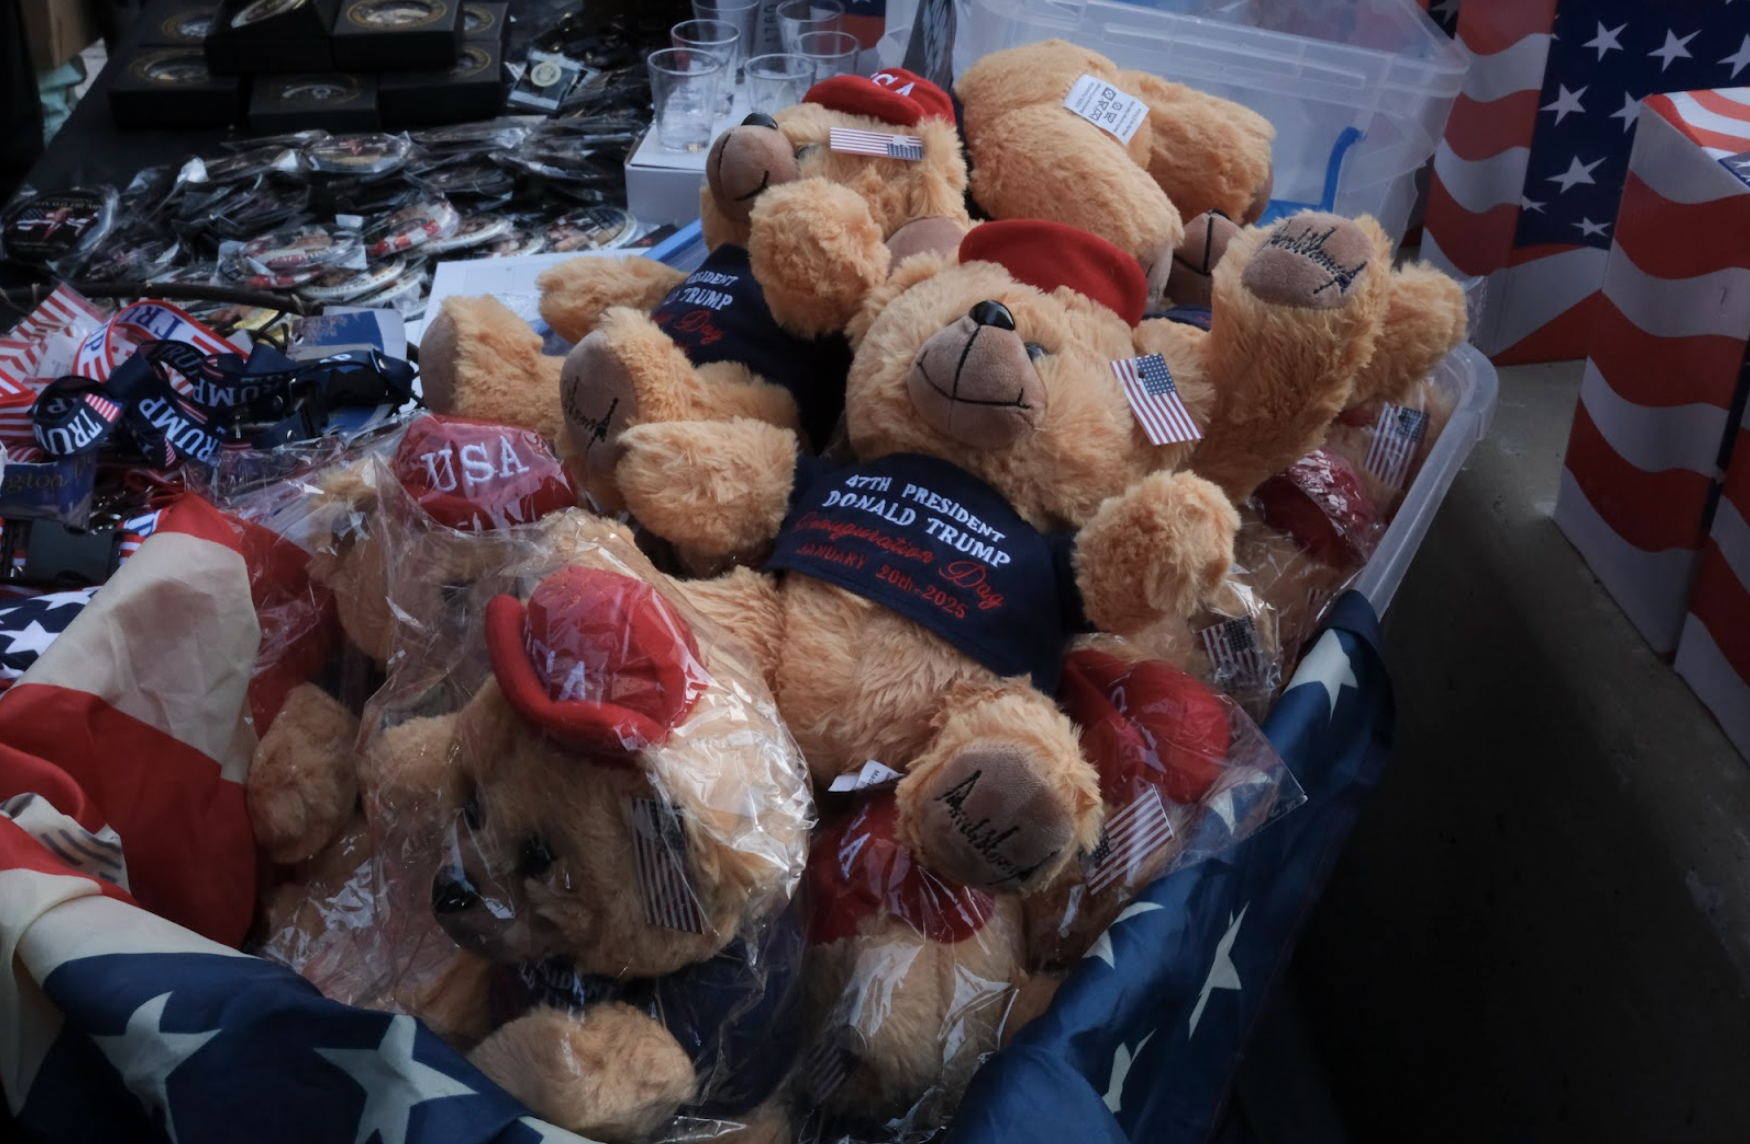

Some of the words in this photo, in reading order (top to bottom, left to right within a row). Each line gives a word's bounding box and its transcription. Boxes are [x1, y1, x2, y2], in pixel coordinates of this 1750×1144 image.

[680, 287, 734, 311] TRUMP
[420, 436, 530, 493] USA
[822, 490, 917, 527] DONALD
[926, 517, 1012, 568] TRUMP
[845, 473, 893, 492] 47TH
[901, 483, 1006, 544] PRESIDENT
[796, 543, 868, 570] JANUARY
[938, 560, 1006, 611] Day
